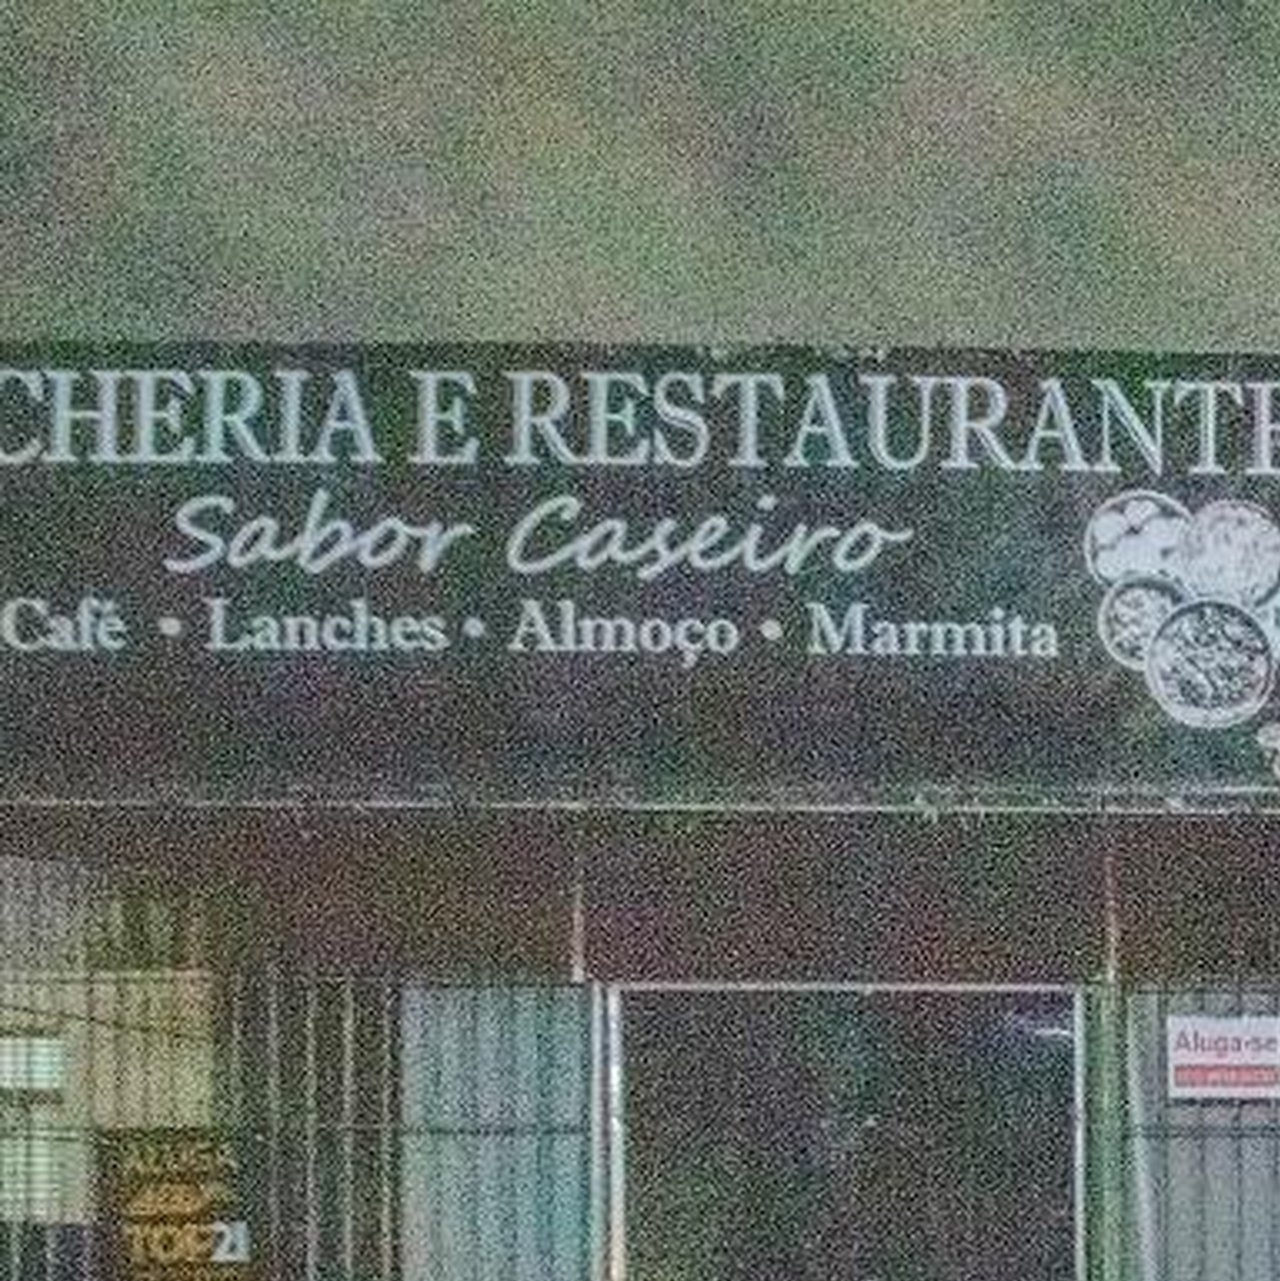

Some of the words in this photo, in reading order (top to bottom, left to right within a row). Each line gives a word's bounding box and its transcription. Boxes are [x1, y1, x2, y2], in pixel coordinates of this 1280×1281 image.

[409, 370, 480, 465] E
[164, 488, 476, 575] Sabor
[506, 495, 914, 576] Caseiro
[2, 596, 127, 653] Café
[207, 597, 449, 653] Lanches
[507, 600, 739, 669] Almoço
[806, 602, 1059, 658] Marmita
[1174, 1029, 1278, 1058] Aluga-se
